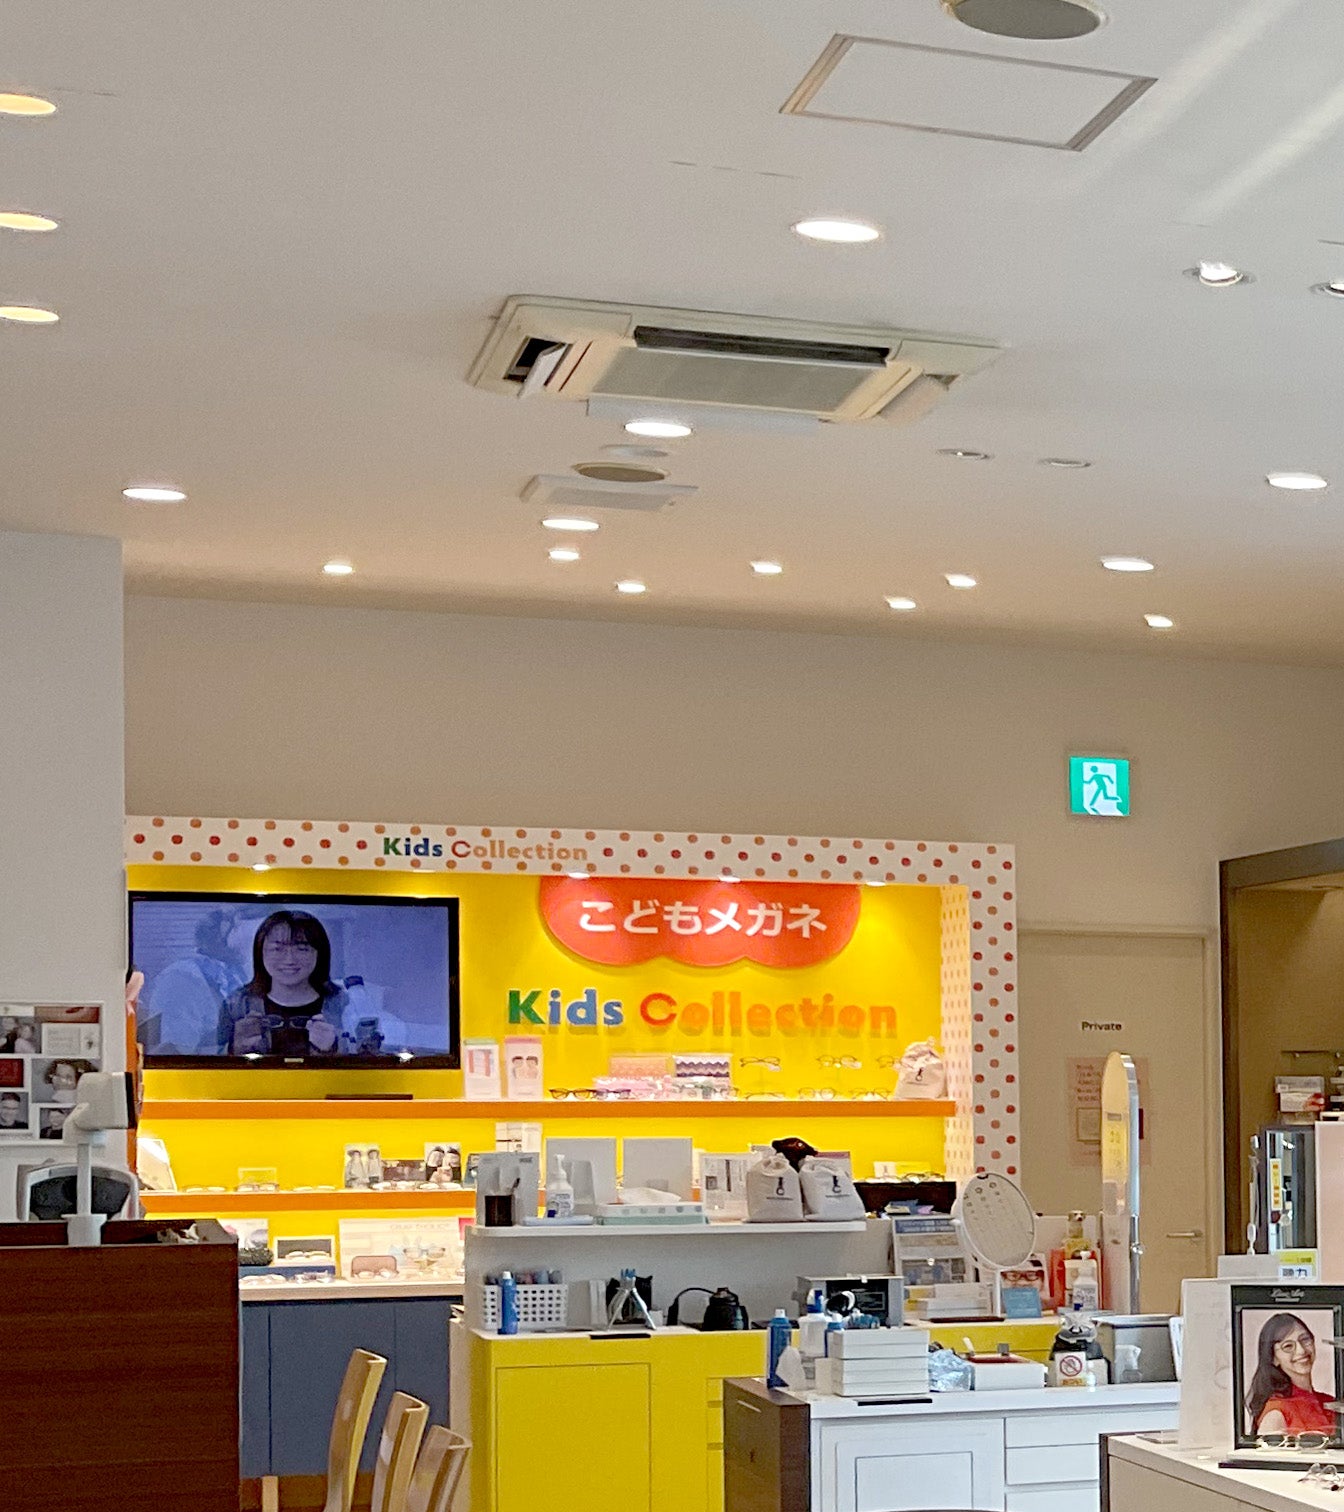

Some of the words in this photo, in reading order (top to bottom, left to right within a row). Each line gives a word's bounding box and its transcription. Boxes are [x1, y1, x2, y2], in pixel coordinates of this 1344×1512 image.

[384, 838, 442, 857] Kids
[452, 840, 587, 861] Collection
[579, 900, 827, 939] こどもメガネ
[509, 989, 623, 1027] Kids
[640, 991, 897, 1031] Collection
[1082, 1021, 1122, 1031] Private
